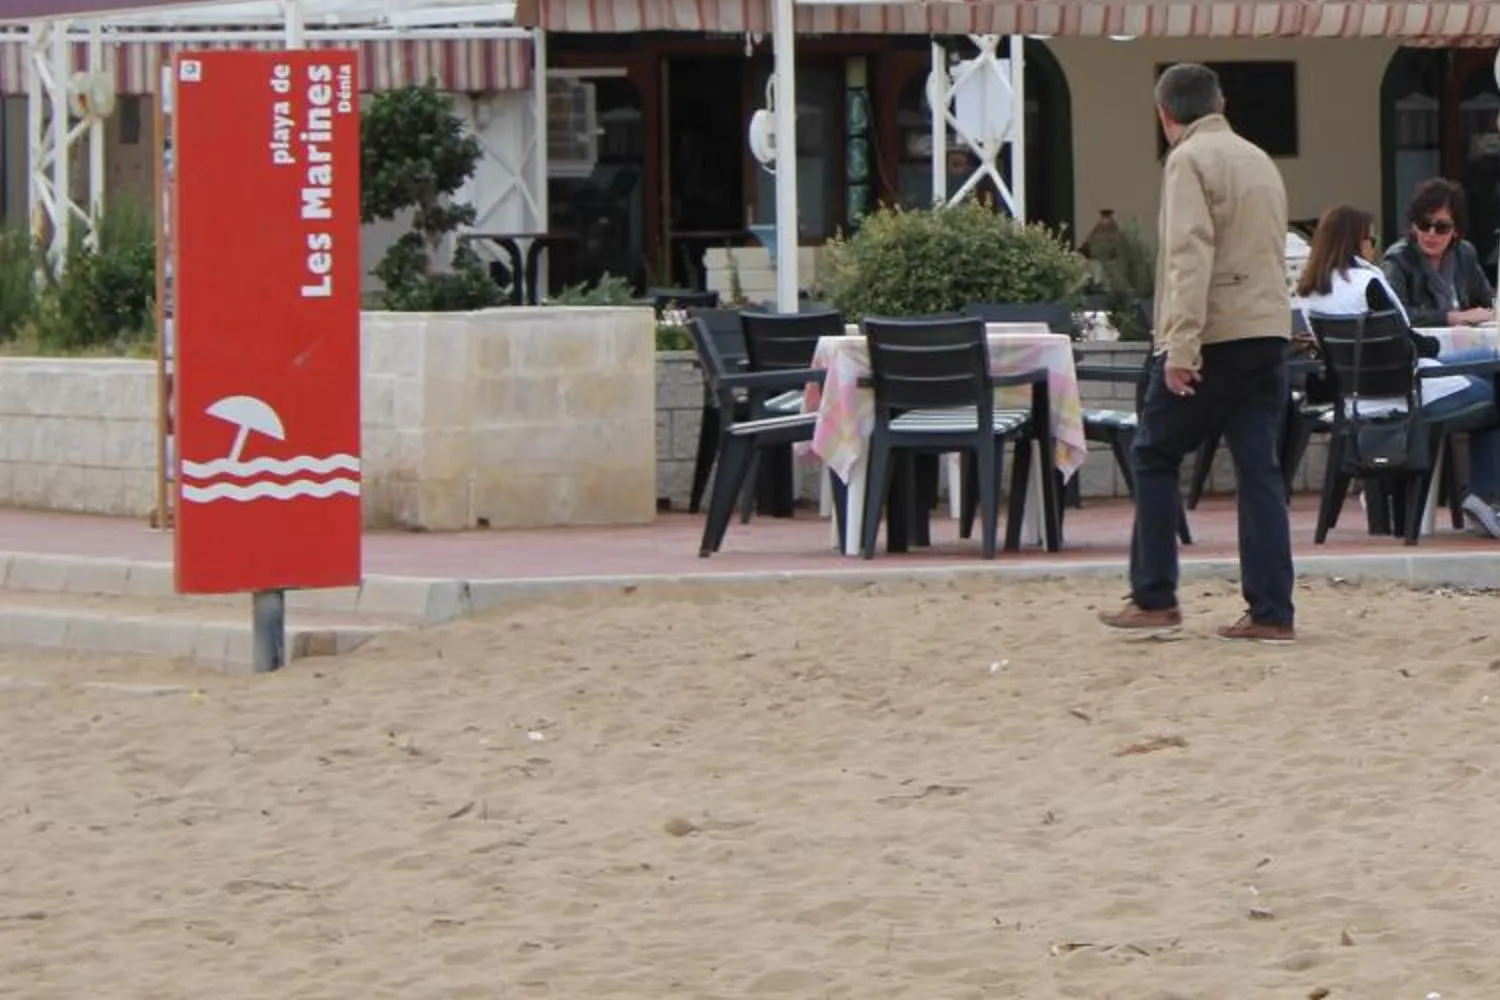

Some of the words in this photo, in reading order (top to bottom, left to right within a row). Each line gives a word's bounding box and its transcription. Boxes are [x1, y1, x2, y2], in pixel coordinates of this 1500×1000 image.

[270, 64, 290, 93] de
[336, 64, 352, 113] Dénia
[270, 101, 296, 165] playa
[300, 64, 333, 219] Marines
[301, 232, 333, 297] Les
